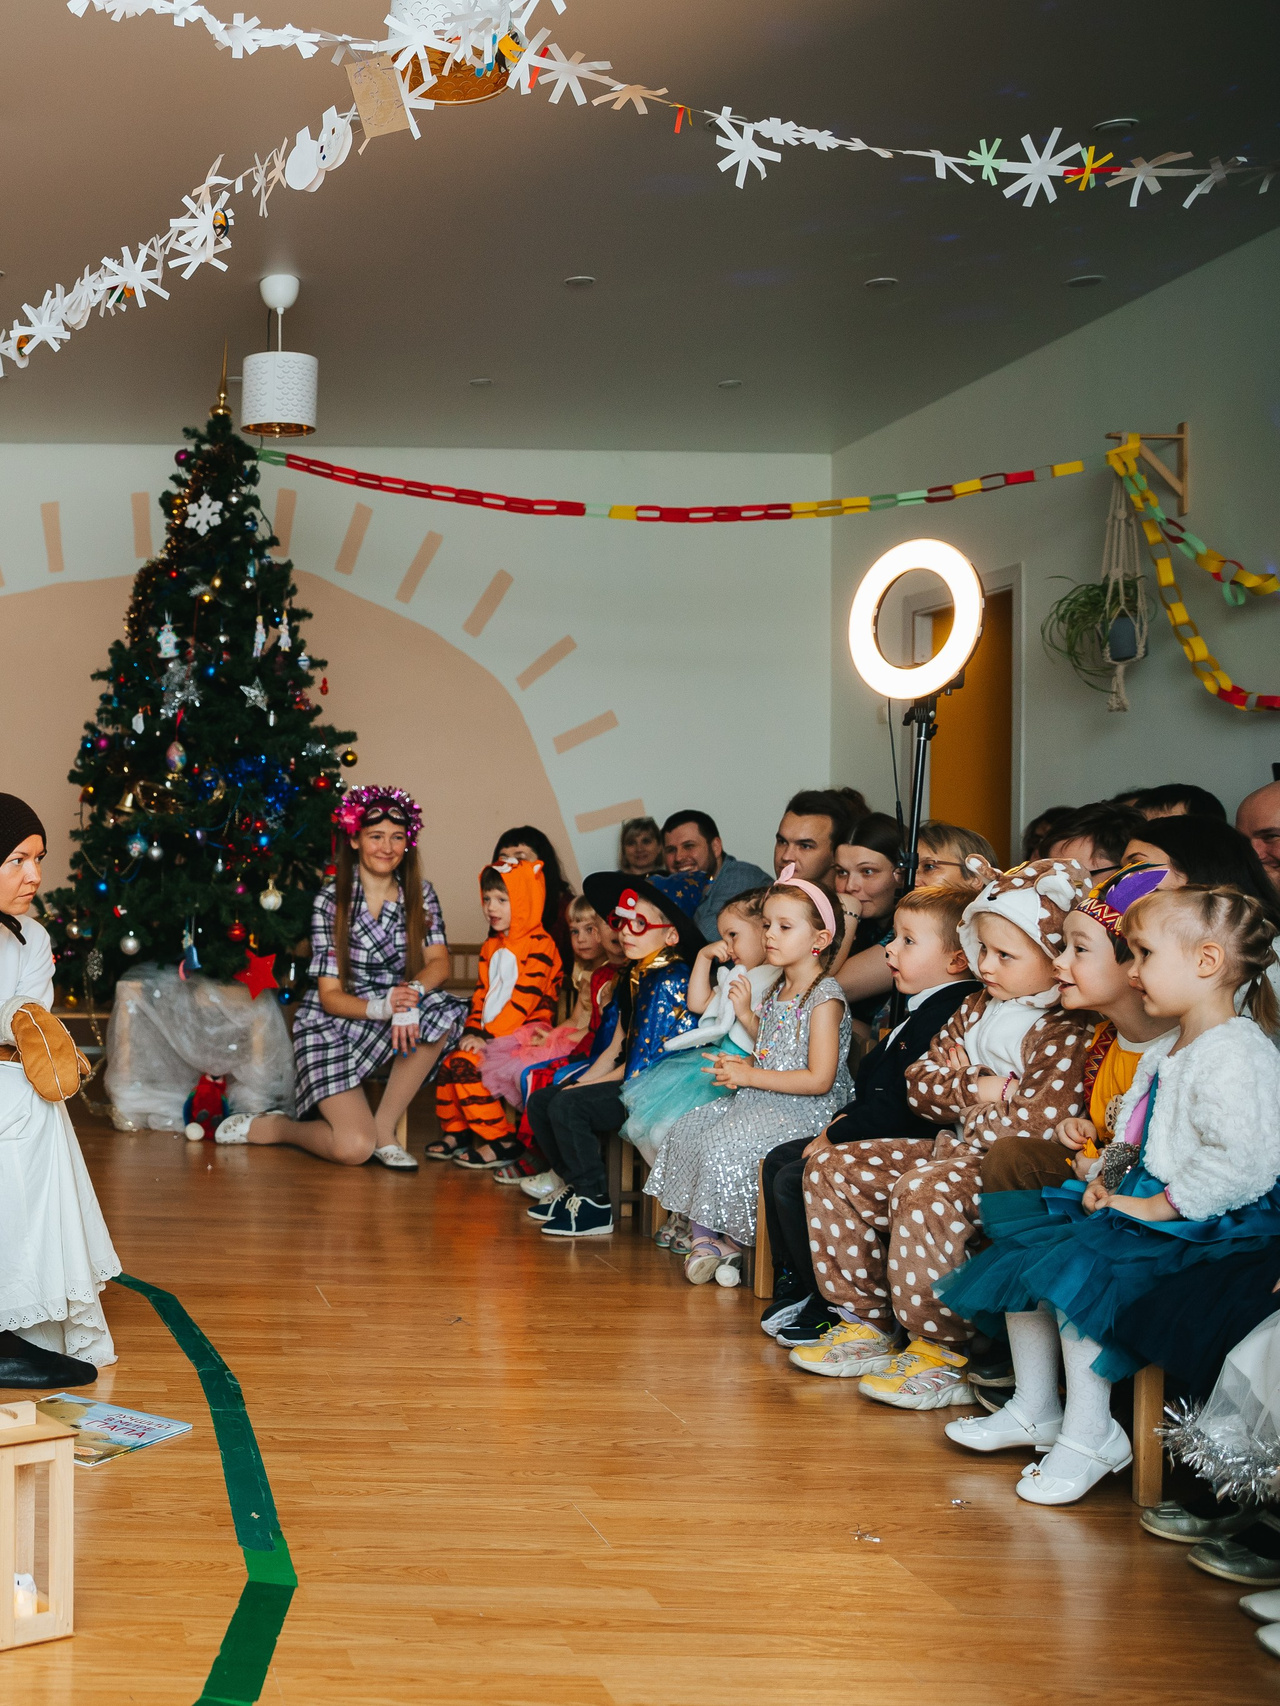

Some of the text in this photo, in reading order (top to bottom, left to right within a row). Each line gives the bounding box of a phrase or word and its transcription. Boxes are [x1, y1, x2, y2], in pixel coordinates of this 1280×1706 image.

[85, 1419, 147, 1439] ПАПА
[106, 1412, 174, 1430] ЛУЧШИЙ
[114, 1419, 156, 1433] МИРЕ
